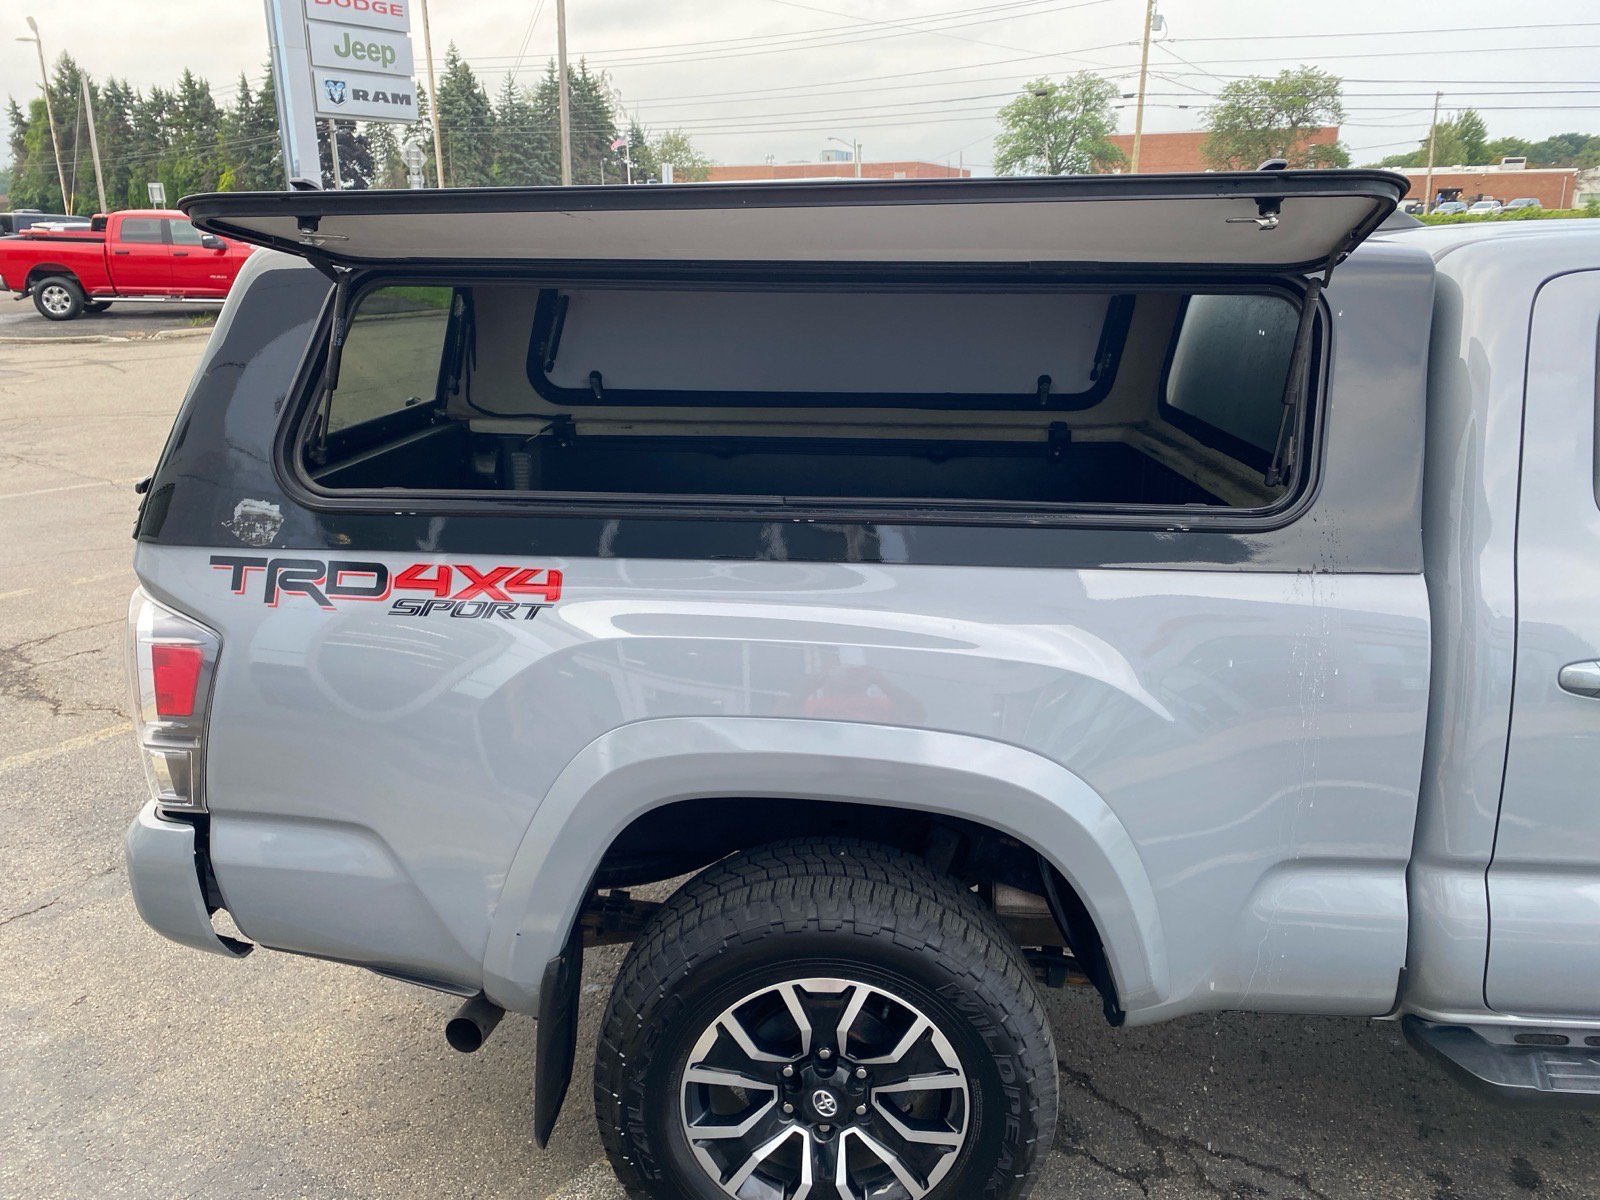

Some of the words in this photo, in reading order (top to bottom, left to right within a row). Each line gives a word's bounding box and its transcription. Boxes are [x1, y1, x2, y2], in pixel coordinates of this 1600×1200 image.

[334, 33, 396, 68] Jeep
[352, 89, 411, 105] RAM
[209, 555, 392, 610] TRD
[393, 563, 563, 602] 4X4
[388, 598, 554, 620] SPORT
[936, 982, 1021, 1199] WILDPEAK
